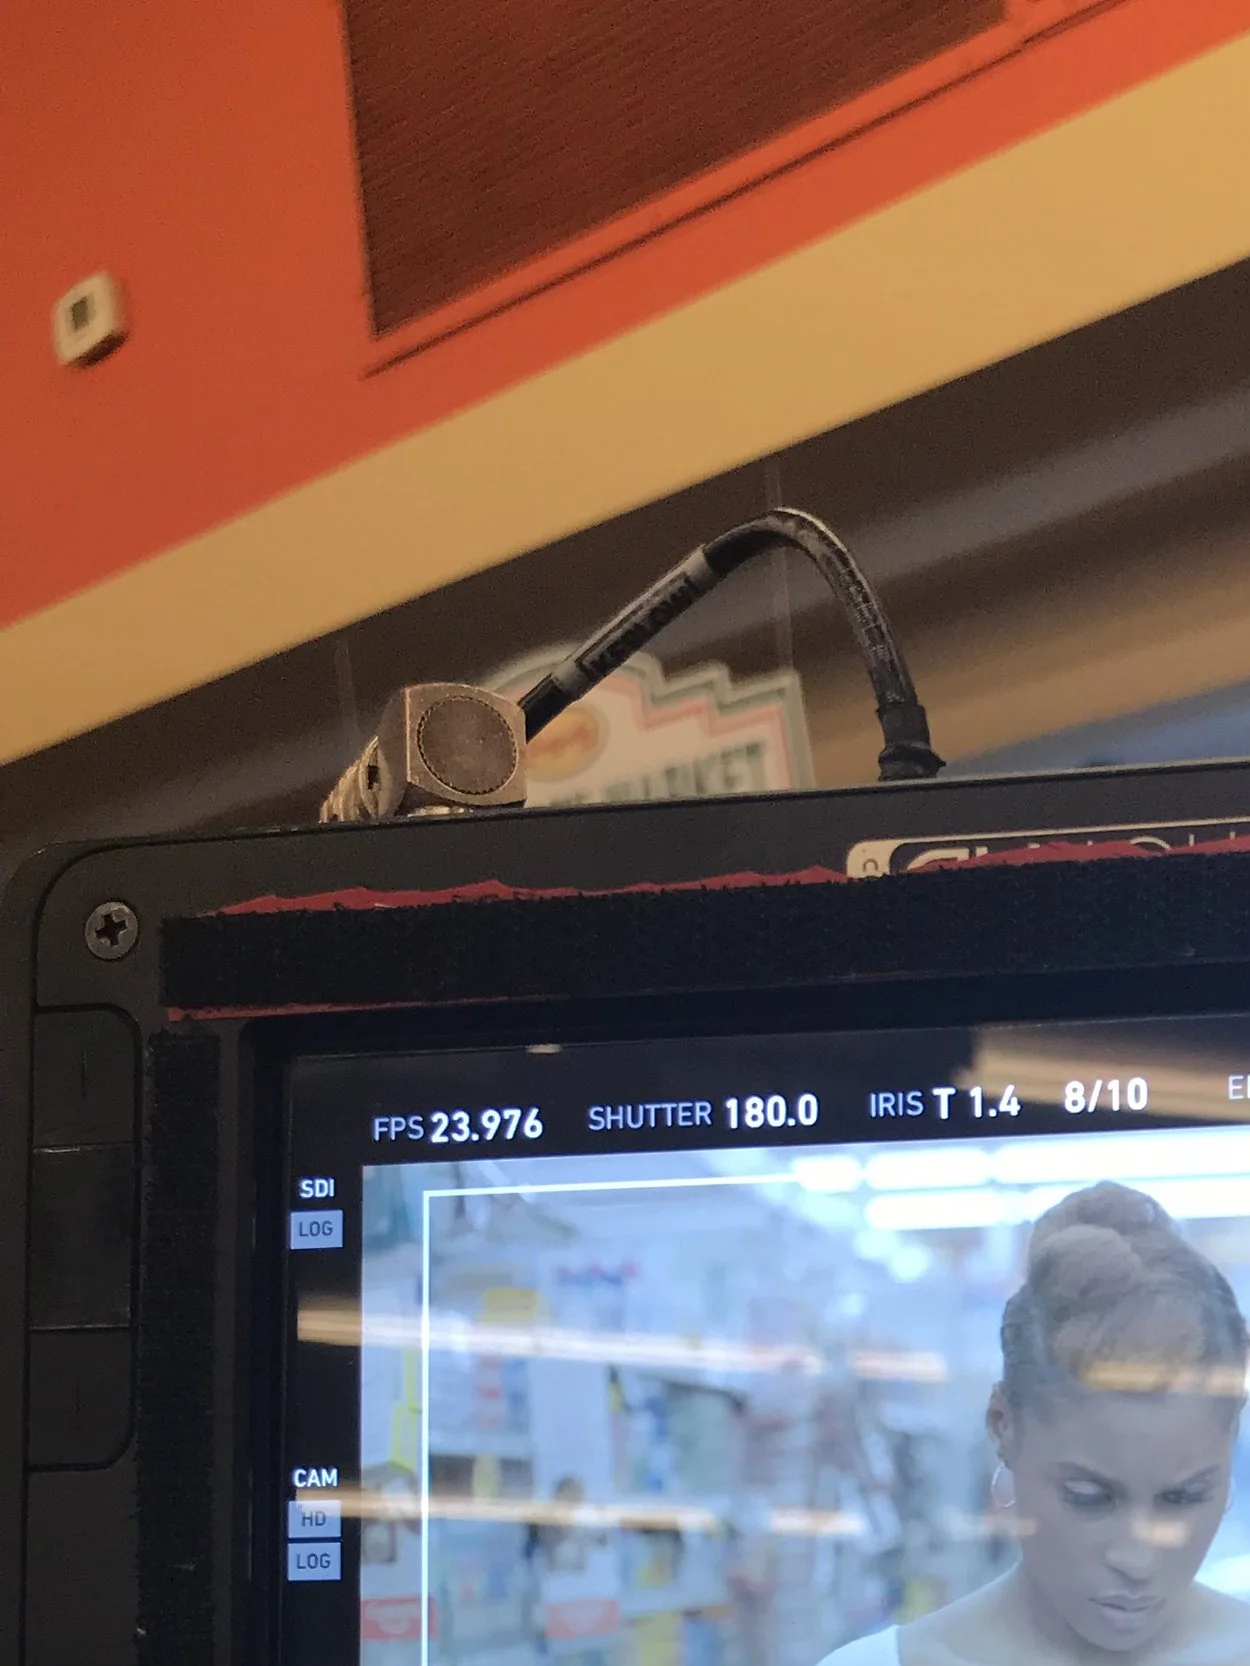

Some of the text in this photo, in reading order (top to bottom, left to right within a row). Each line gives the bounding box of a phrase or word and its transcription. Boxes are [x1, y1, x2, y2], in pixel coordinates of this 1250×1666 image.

[869, 1084, 1022, 1120] IRIS T 1.4
[1063, 1077, 1149, 1114] 8/10
[587, 1092, 819, 1131] SHUTTER 180.0
[373, 1106, 543, 1144] FPS 23.976
[299, 1178, 335, 1198] SDI
[298, 1220, 334, 1237] LOG
[293, 1468, 338, 1488] CAM
[301, 1510, 326, 1527] HD
[295, 1553, 331, 1570] LOG
